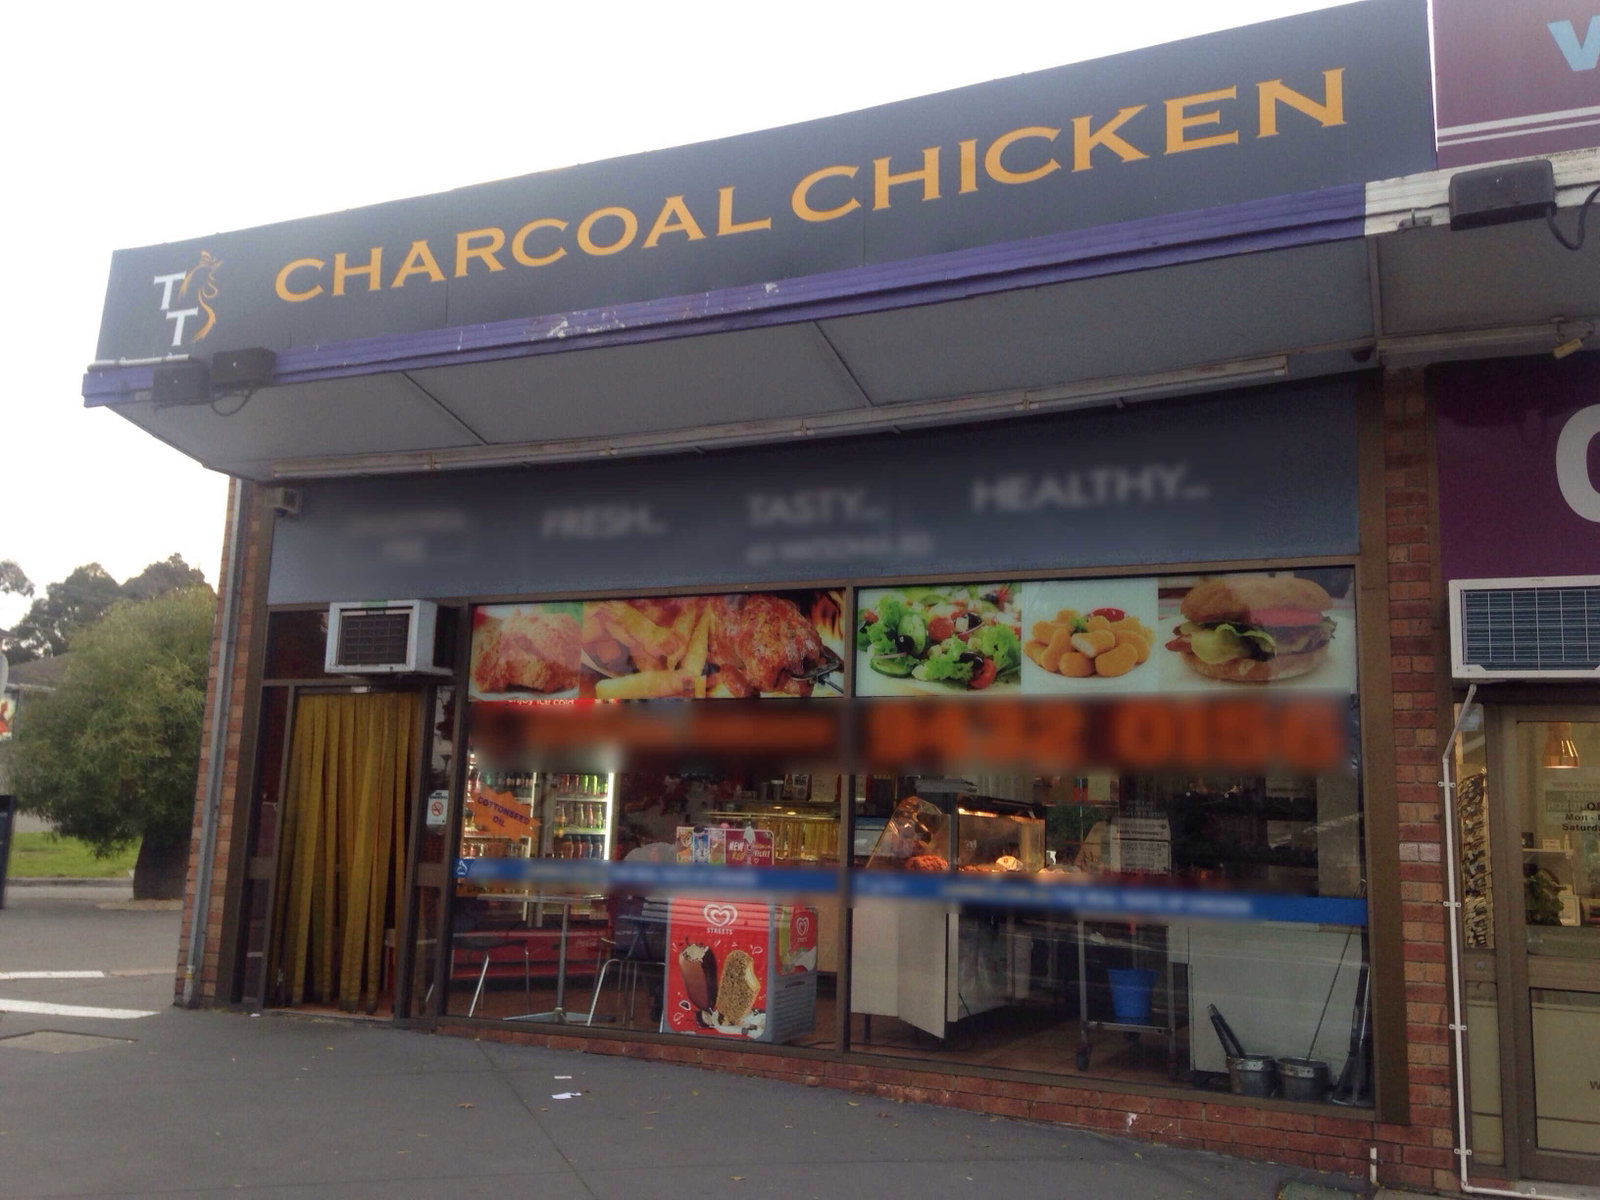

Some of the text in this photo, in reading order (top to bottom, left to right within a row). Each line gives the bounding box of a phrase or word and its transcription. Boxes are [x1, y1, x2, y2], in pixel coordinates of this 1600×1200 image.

[274, 67, 1347, 302] CHARCOAL CHICKEN
[1562, 823, 1600, 832] Saturd
[706, 927, 733, 936] STREETS
